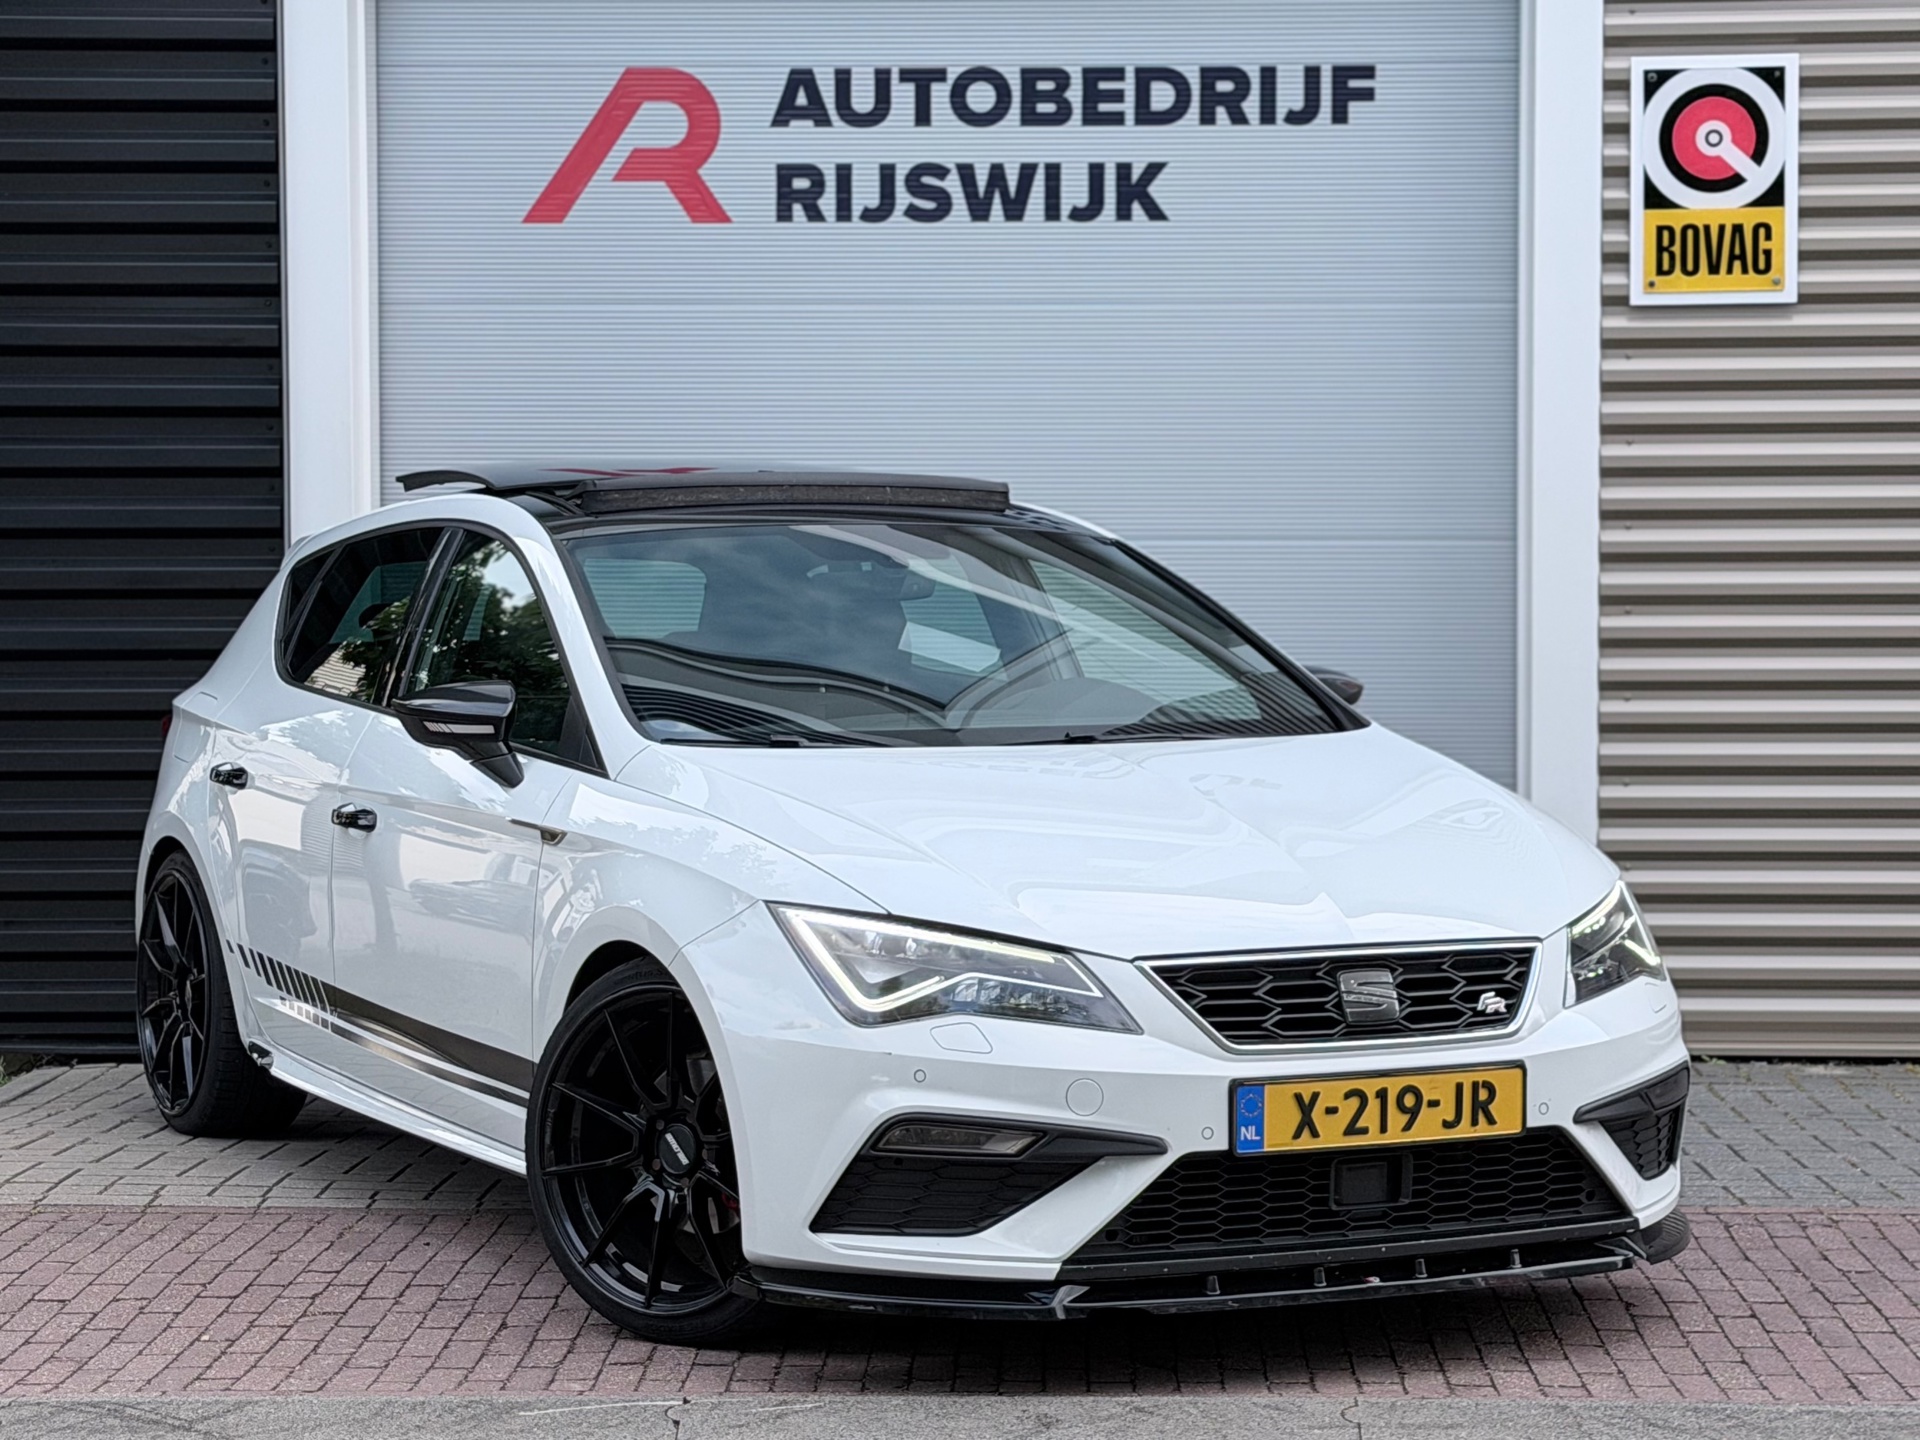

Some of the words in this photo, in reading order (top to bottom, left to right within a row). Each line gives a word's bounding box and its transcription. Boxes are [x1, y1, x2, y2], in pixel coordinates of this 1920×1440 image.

[770, 65, 1376, 128] AUTOBEDRIJF
[776, 162, 1170, 223] RIJSWIJK
[1655, 221, 1773, 277] BOVAG
[1239, 1125, 1261, 1141] NL
[1291, 1079, 1498, 1141] X-219-JR
